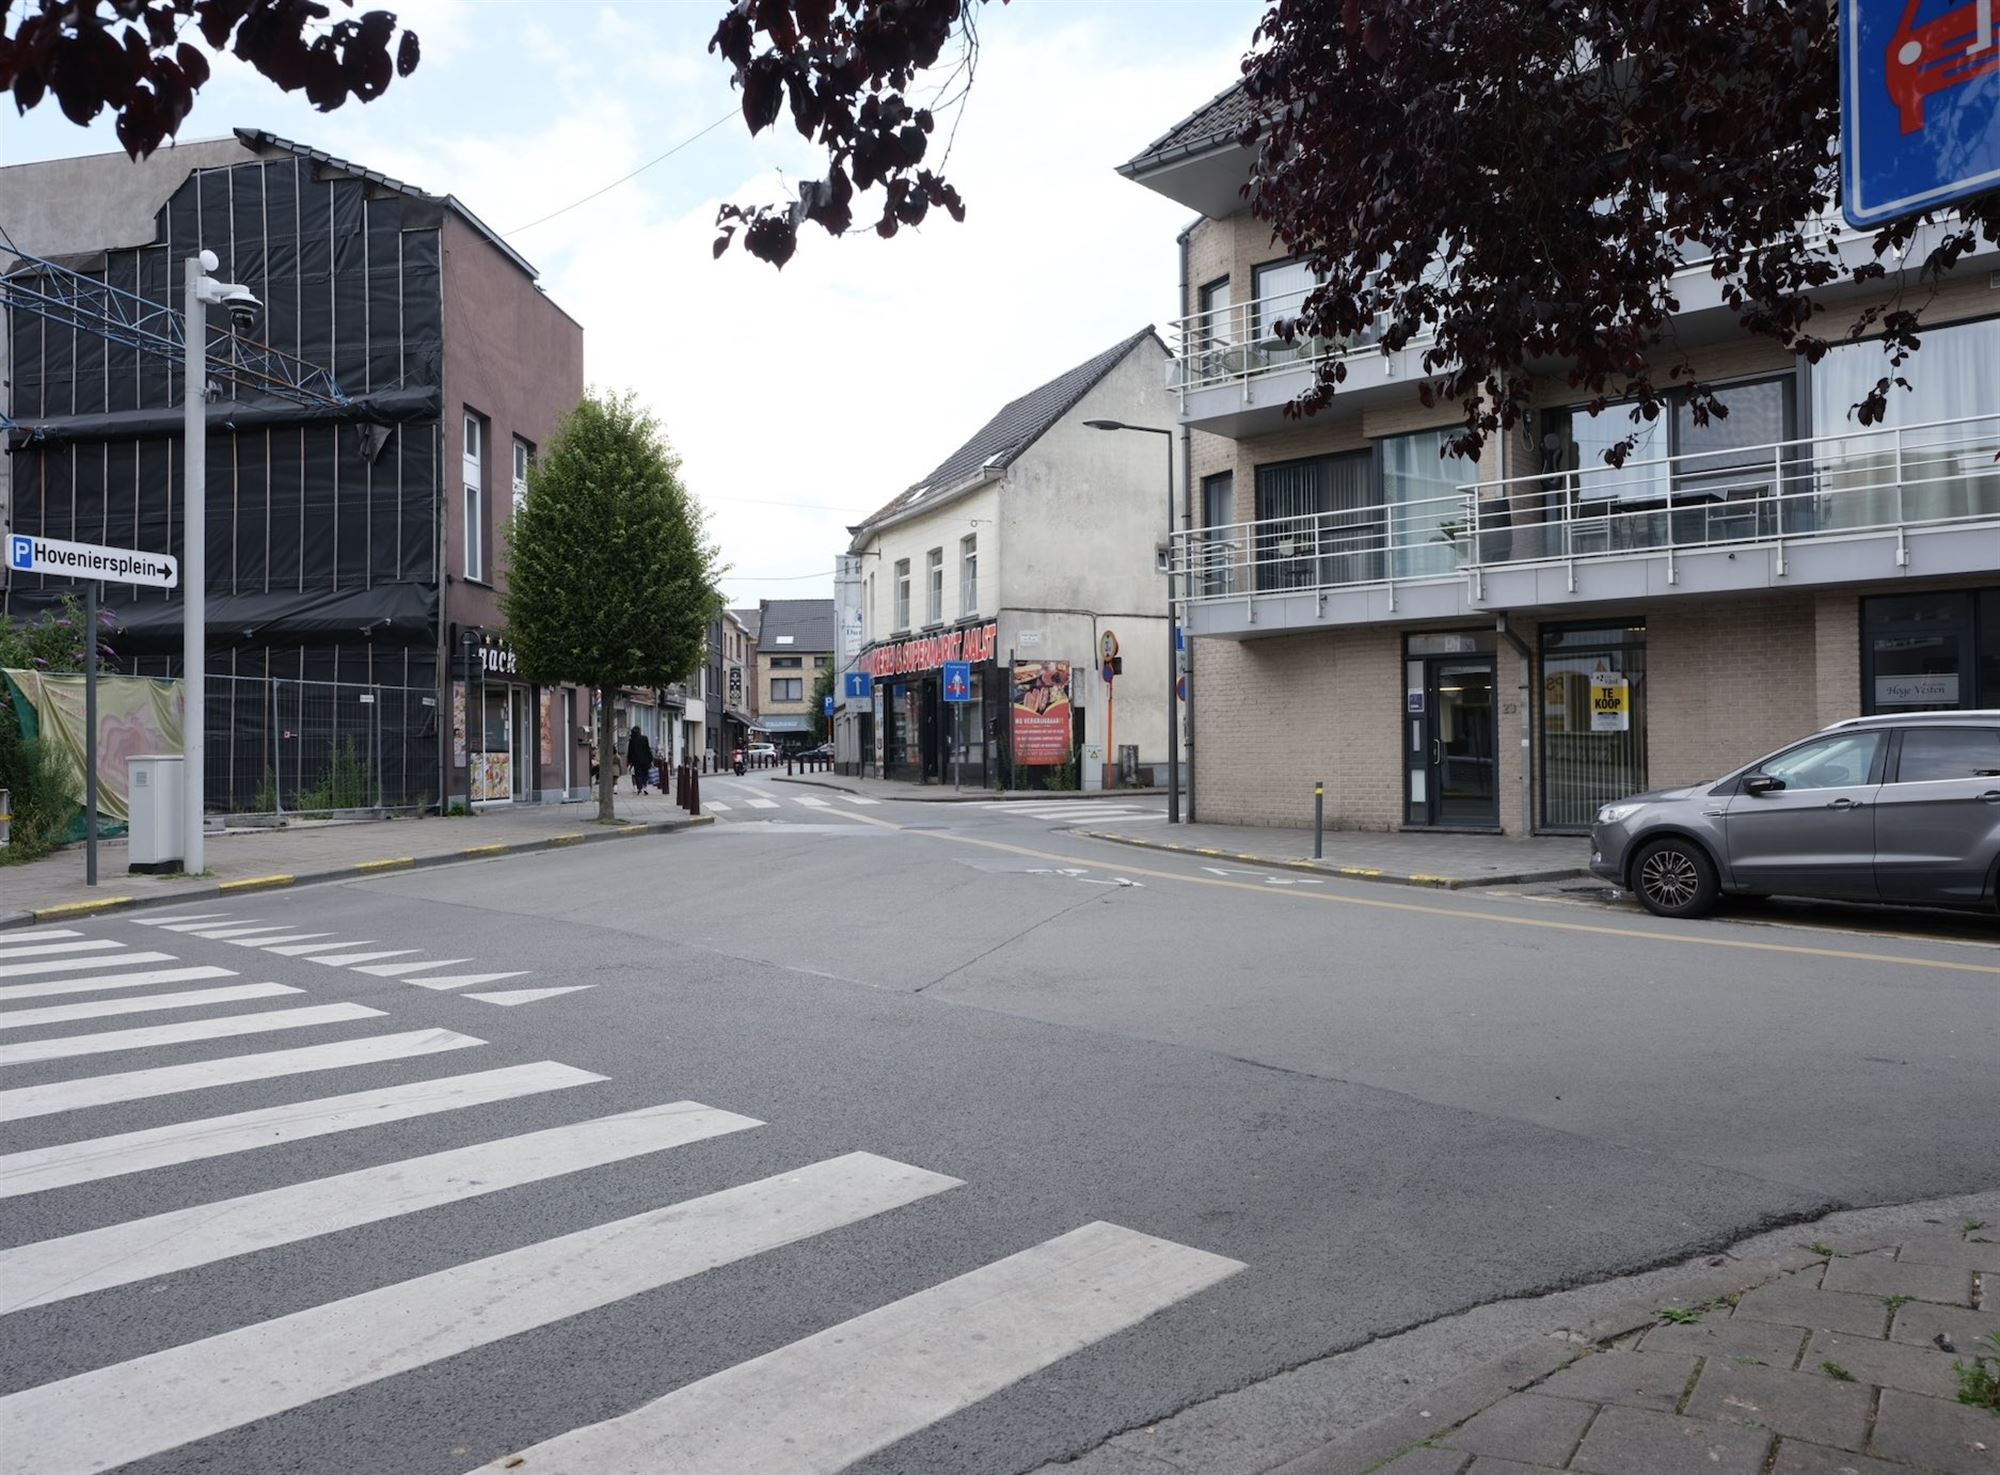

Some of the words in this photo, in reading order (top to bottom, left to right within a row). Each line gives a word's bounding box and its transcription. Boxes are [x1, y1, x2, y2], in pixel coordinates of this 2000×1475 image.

[15, 542, 30, 562] P
[34, 542, 157, 577] Hoveniersplein
[901, 631, 962, 673] SUPERMARKT
[962, 623, 997, 663] AALST
[471, 647, 517, 674] nack
[825, 697, 833, 707] P
[1602, 688, 1614, 698] TE
[1595, 699, 1621, 709] KOOP
